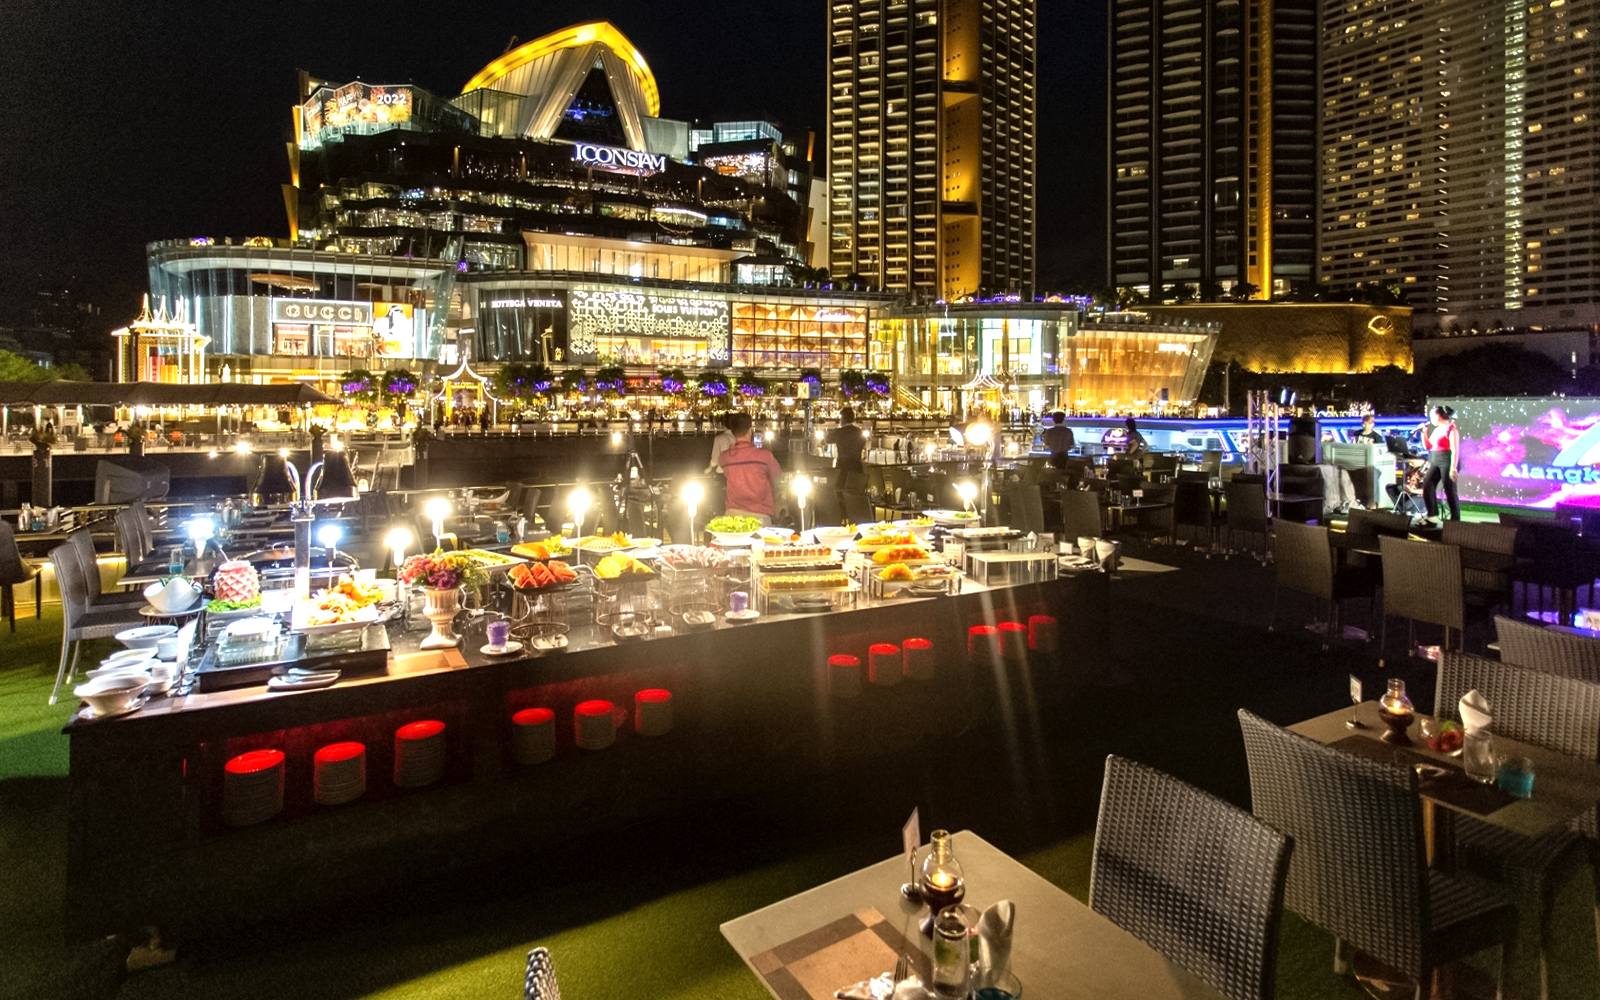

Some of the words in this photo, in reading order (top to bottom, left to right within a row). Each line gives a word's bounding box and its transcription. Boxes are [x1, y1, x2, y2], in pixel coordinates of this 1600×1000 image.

[377, 94, 407, 105] 2022
[575, 143, 666, 172] ICONSIAM
[491, 299, 526, 309] BOTTEGA
[527, 299, 563, 308] VENETA
[652, 304, 678, 314] LOUIS
[680, 306, 718, 316] VUITTON
[286, 304, 360, 321] GUCCI
